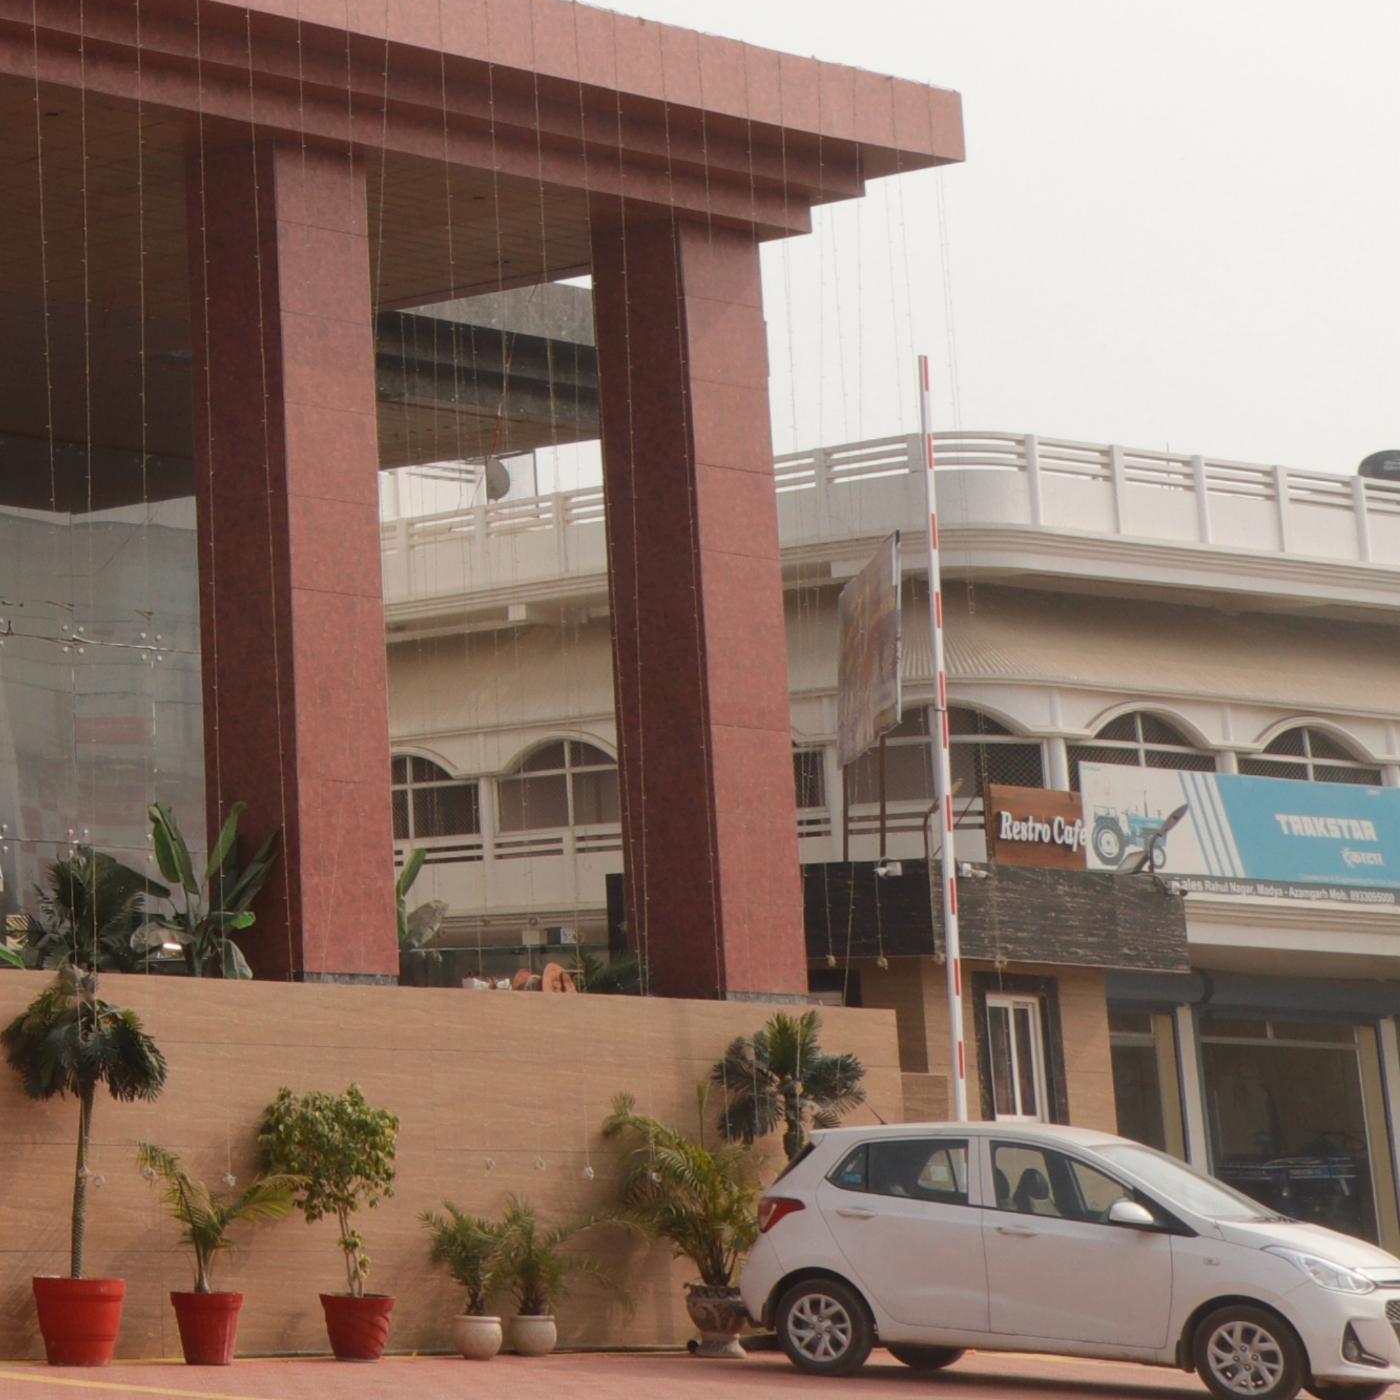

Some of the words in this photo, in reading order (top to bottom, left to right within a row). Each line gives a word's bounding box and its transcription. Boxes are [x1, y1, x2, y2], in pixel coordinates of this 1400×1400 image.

[999, 811, 1051, 843] Restro
[1053, 816, 1089, 852] Cafe
[1274, 813, 1379, 841] TRAKSTAR
